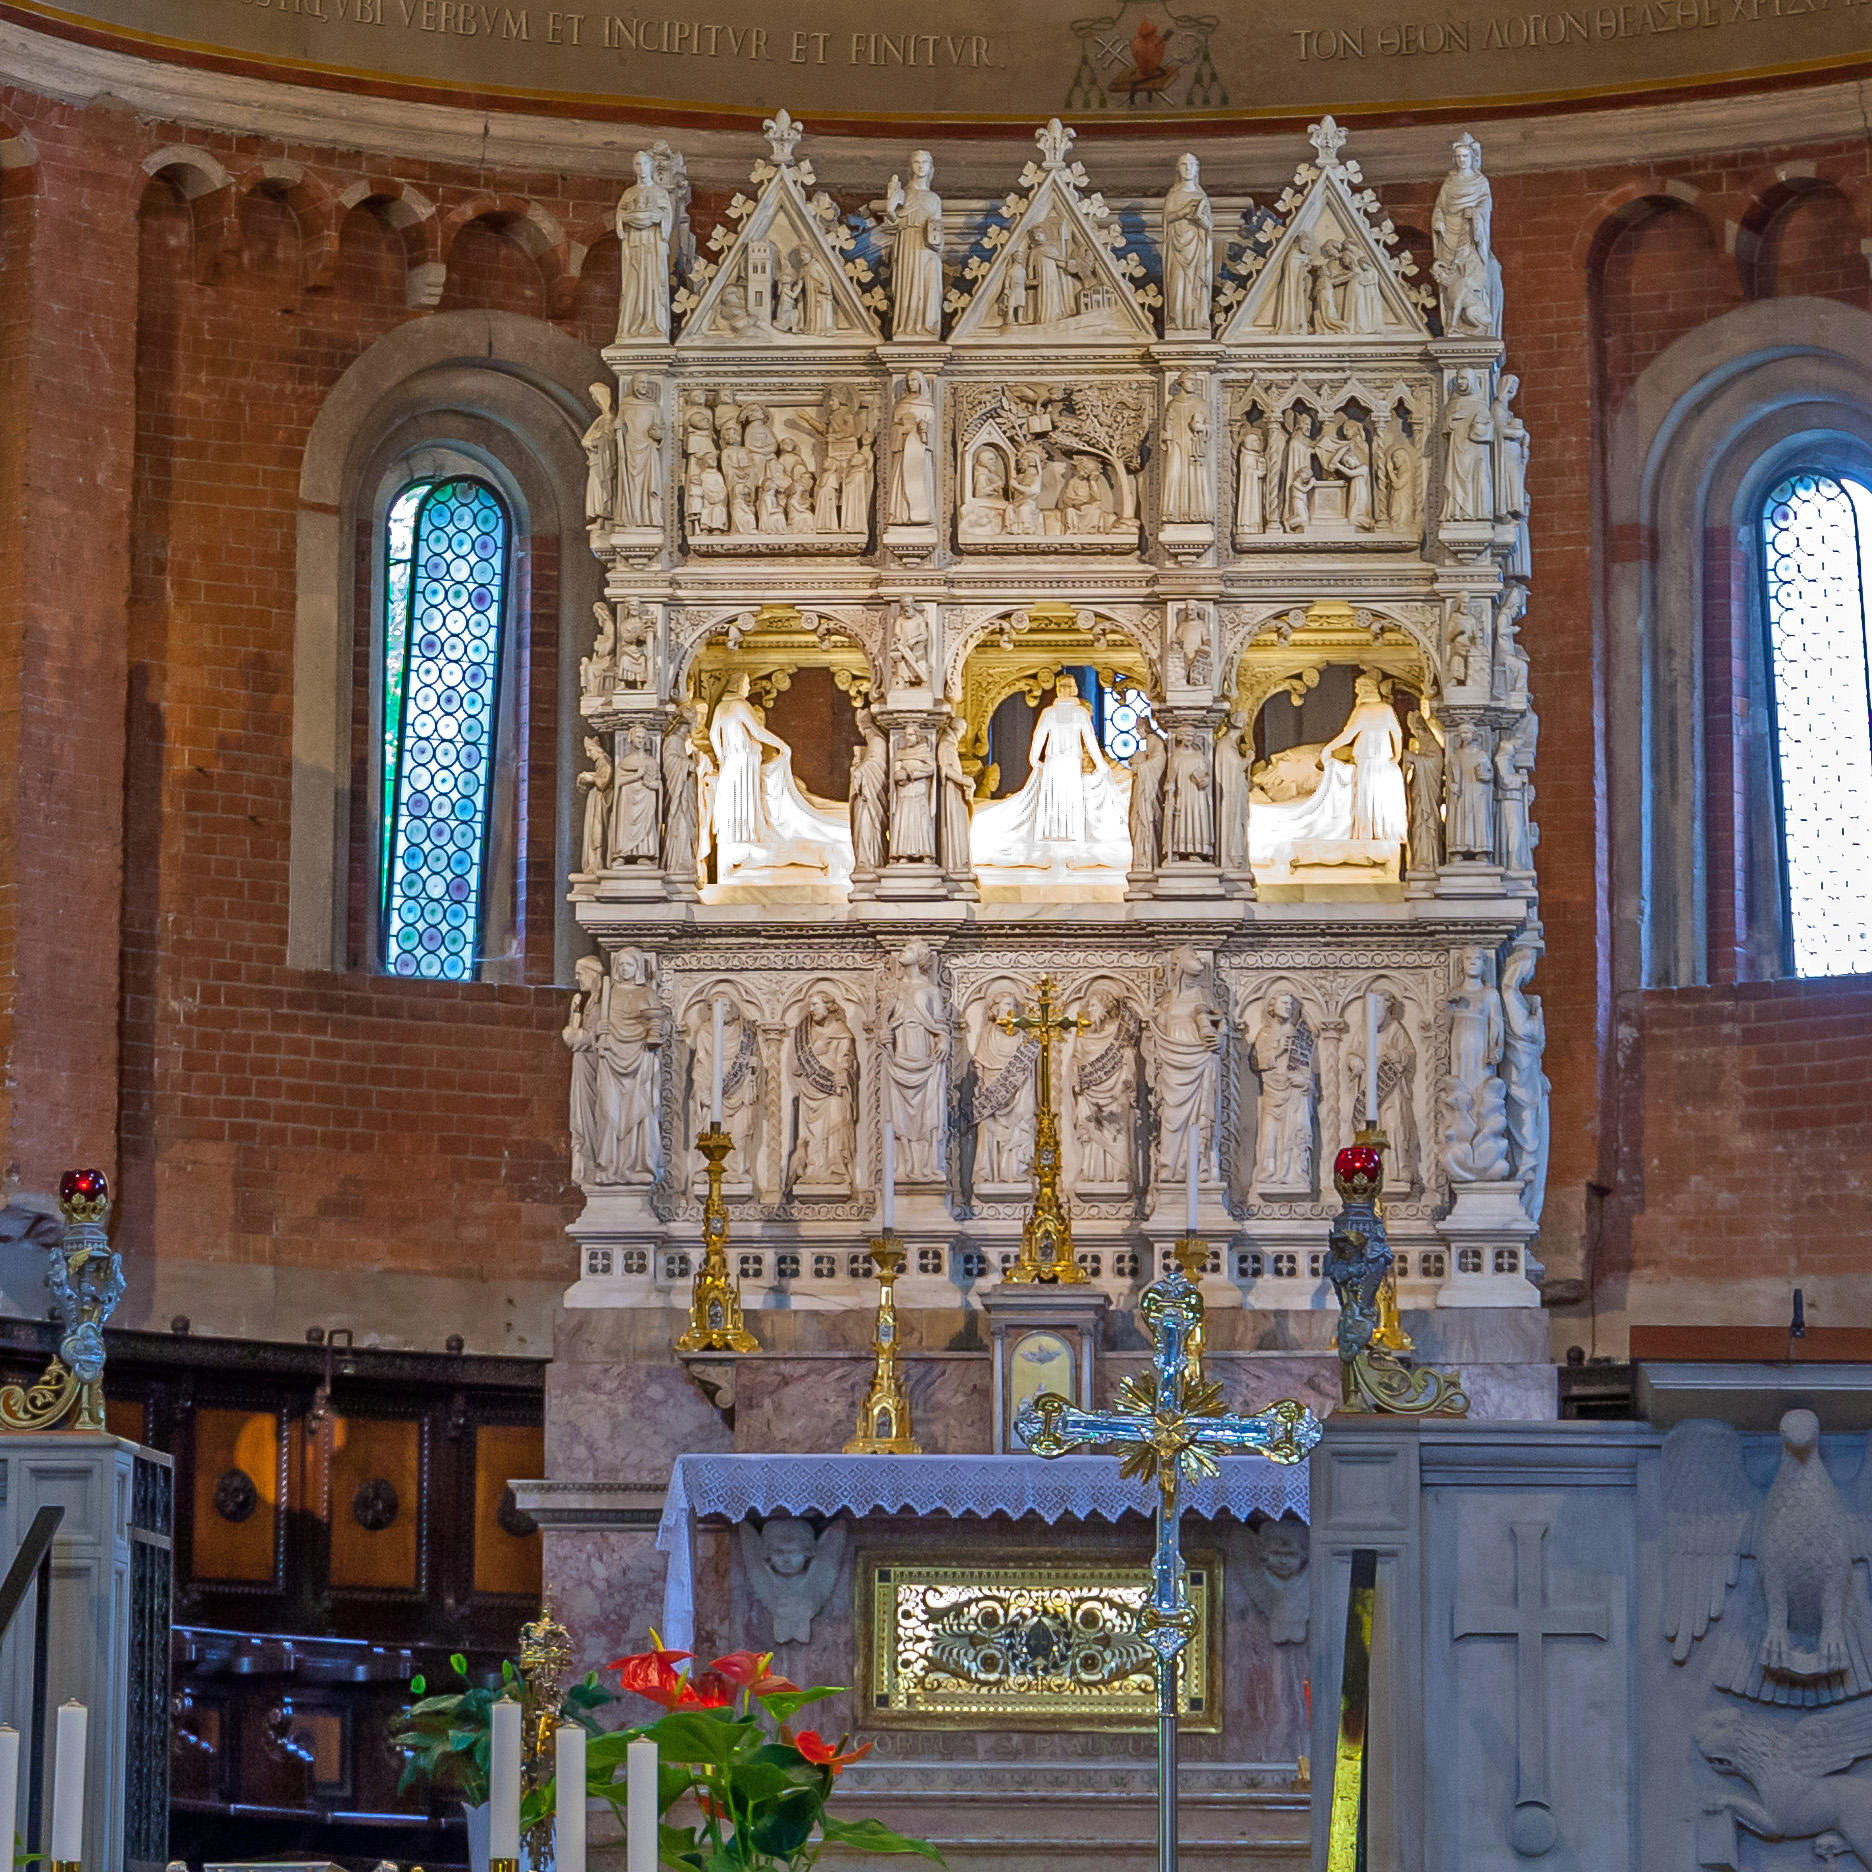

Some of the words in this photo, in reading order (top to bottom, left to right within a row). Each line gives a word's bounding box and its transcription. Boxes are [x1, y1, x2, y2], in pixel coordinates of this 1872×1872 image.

[546, 10, 585, 47] ET
[602, 14, 774, 61] INCIPITVR
[789, 30, 832, 65] ET
